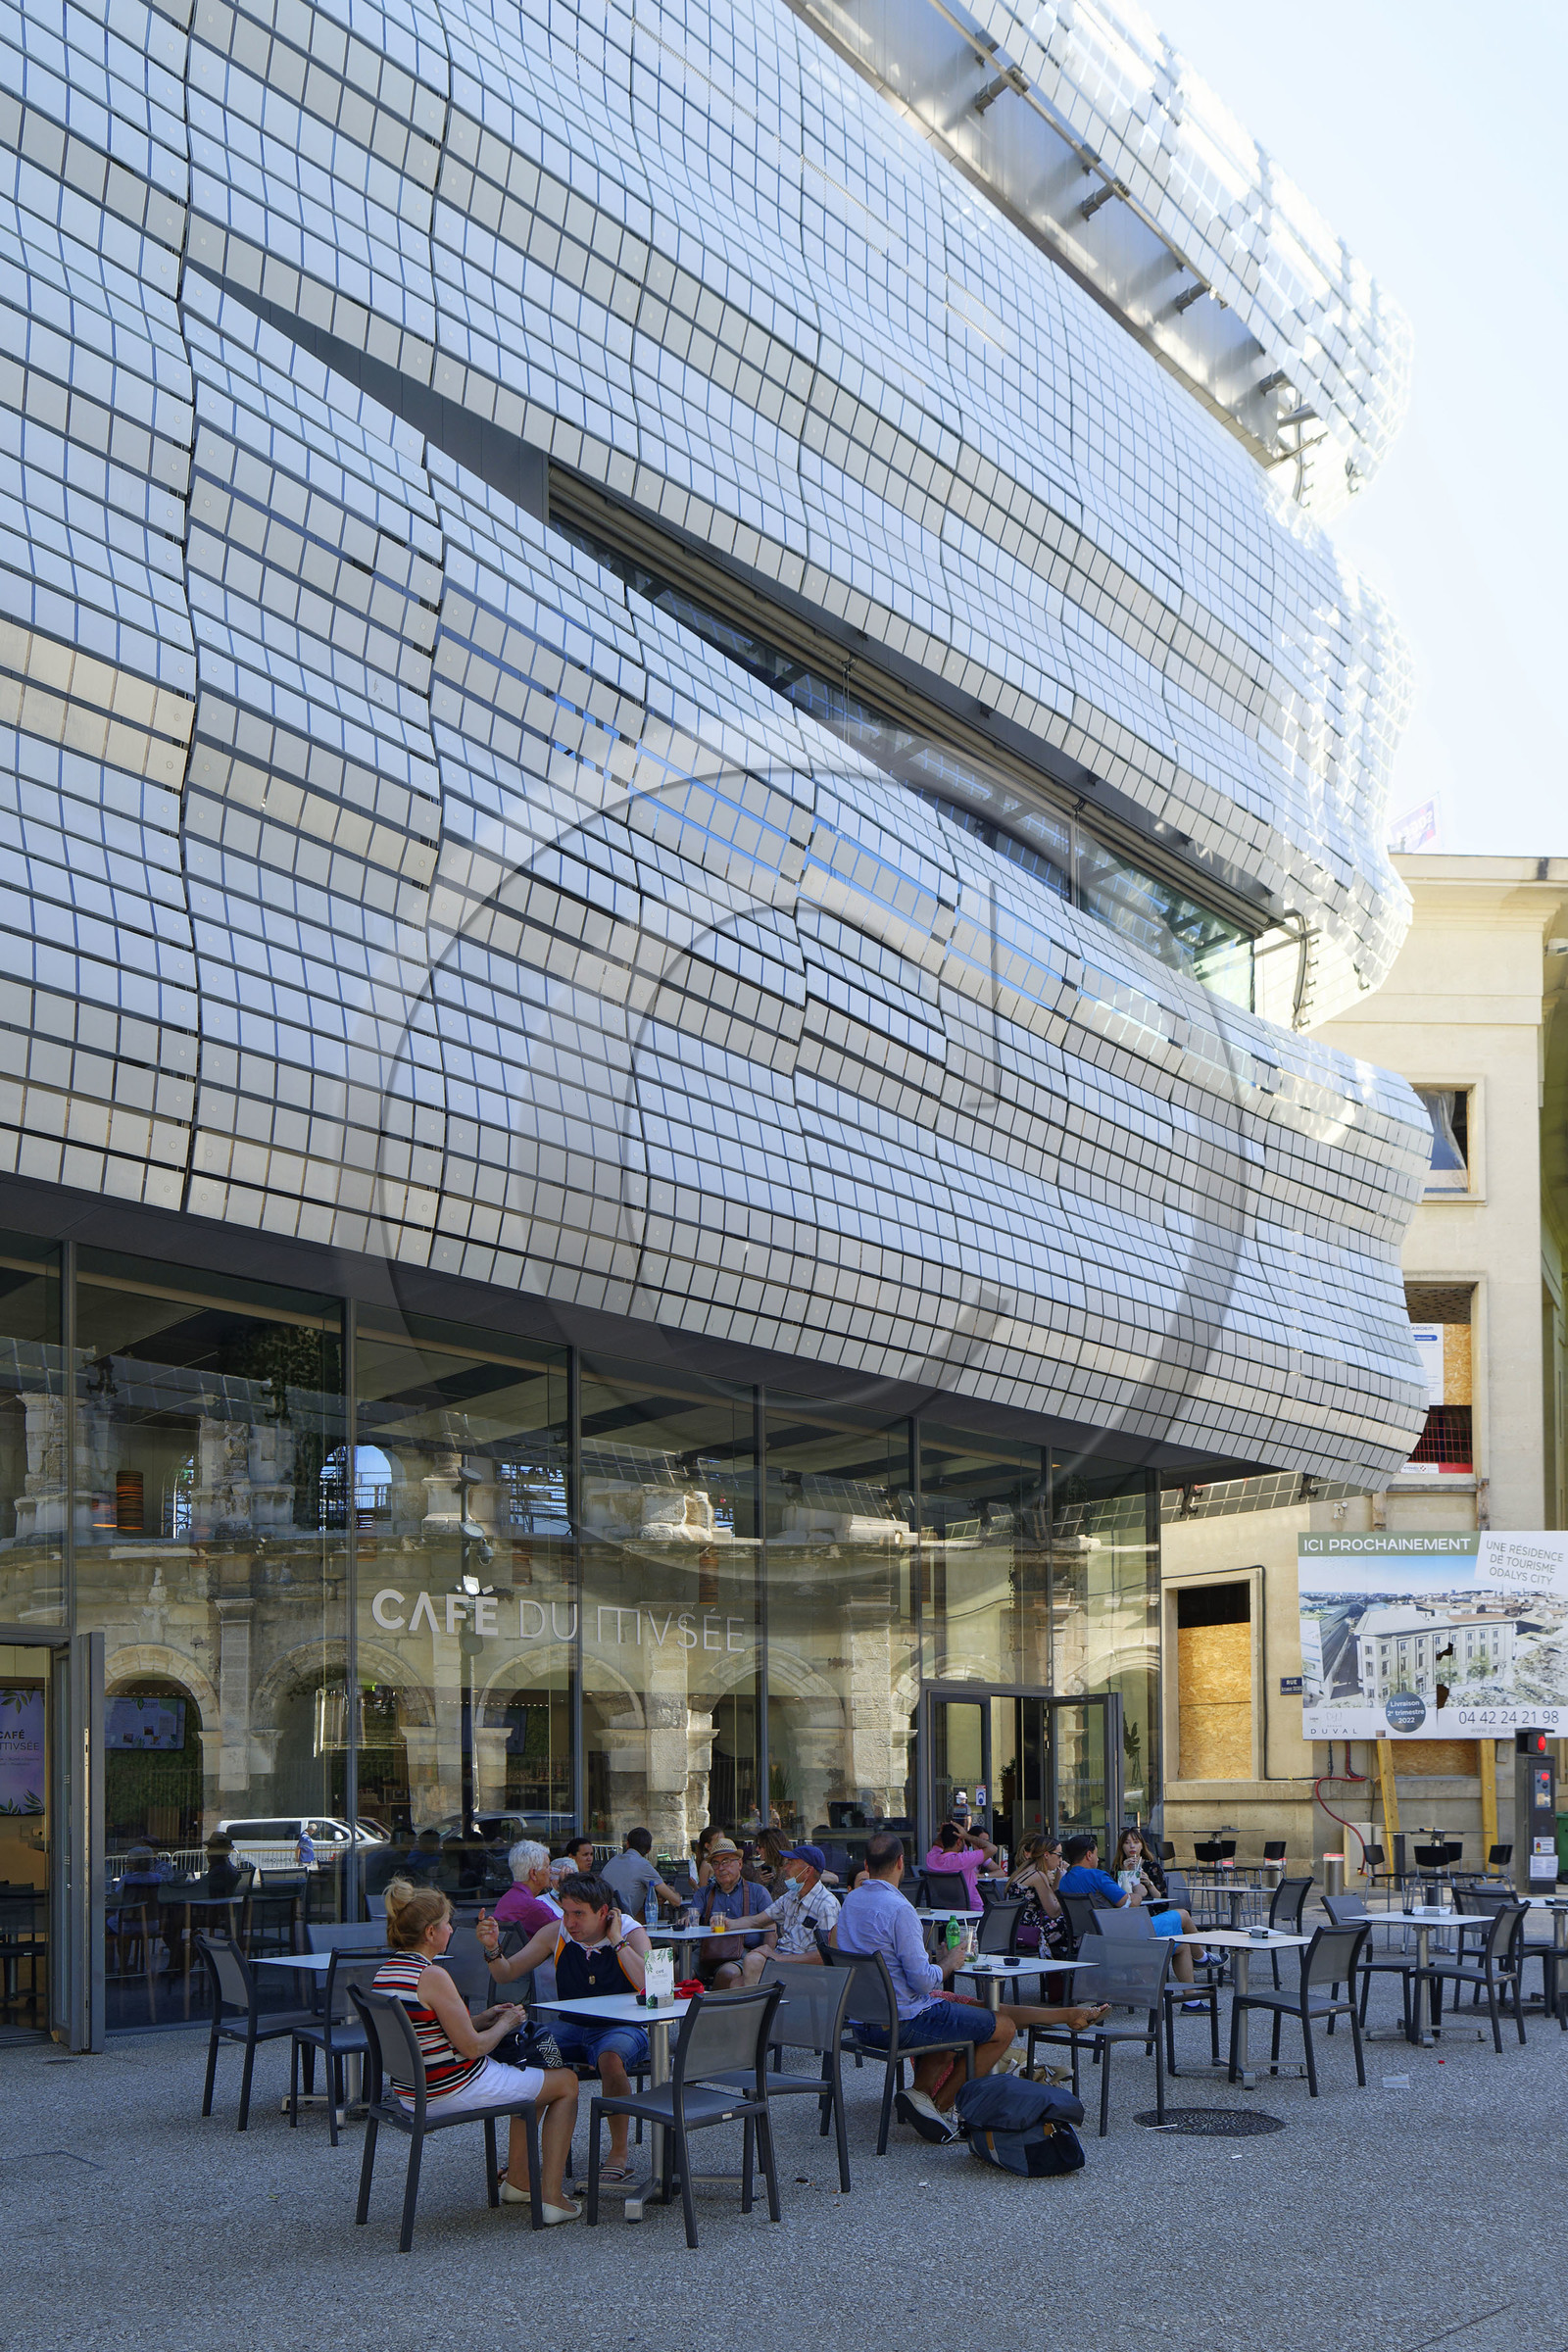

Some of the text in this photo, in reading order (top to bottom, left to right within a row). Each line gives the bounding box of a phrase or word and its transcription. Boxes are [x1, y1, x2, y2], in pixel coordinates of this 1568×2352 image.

[1303, 1538, 1472, 1551] ICI PROCHAINEMENT
[1486, 1540, 1564, 1562] UNE RÉSIDENCE
[1490, 1553, 1556, 1574] DE TOURISME
[1490, 1566, 1553, 1586] ODALYS CITY
[371, 1585, 499, 1637] CAFÉ
[518, 1599, 577, 1641] DU
[1459, 1710, 1559, 1724] 04 42 24 21 98
